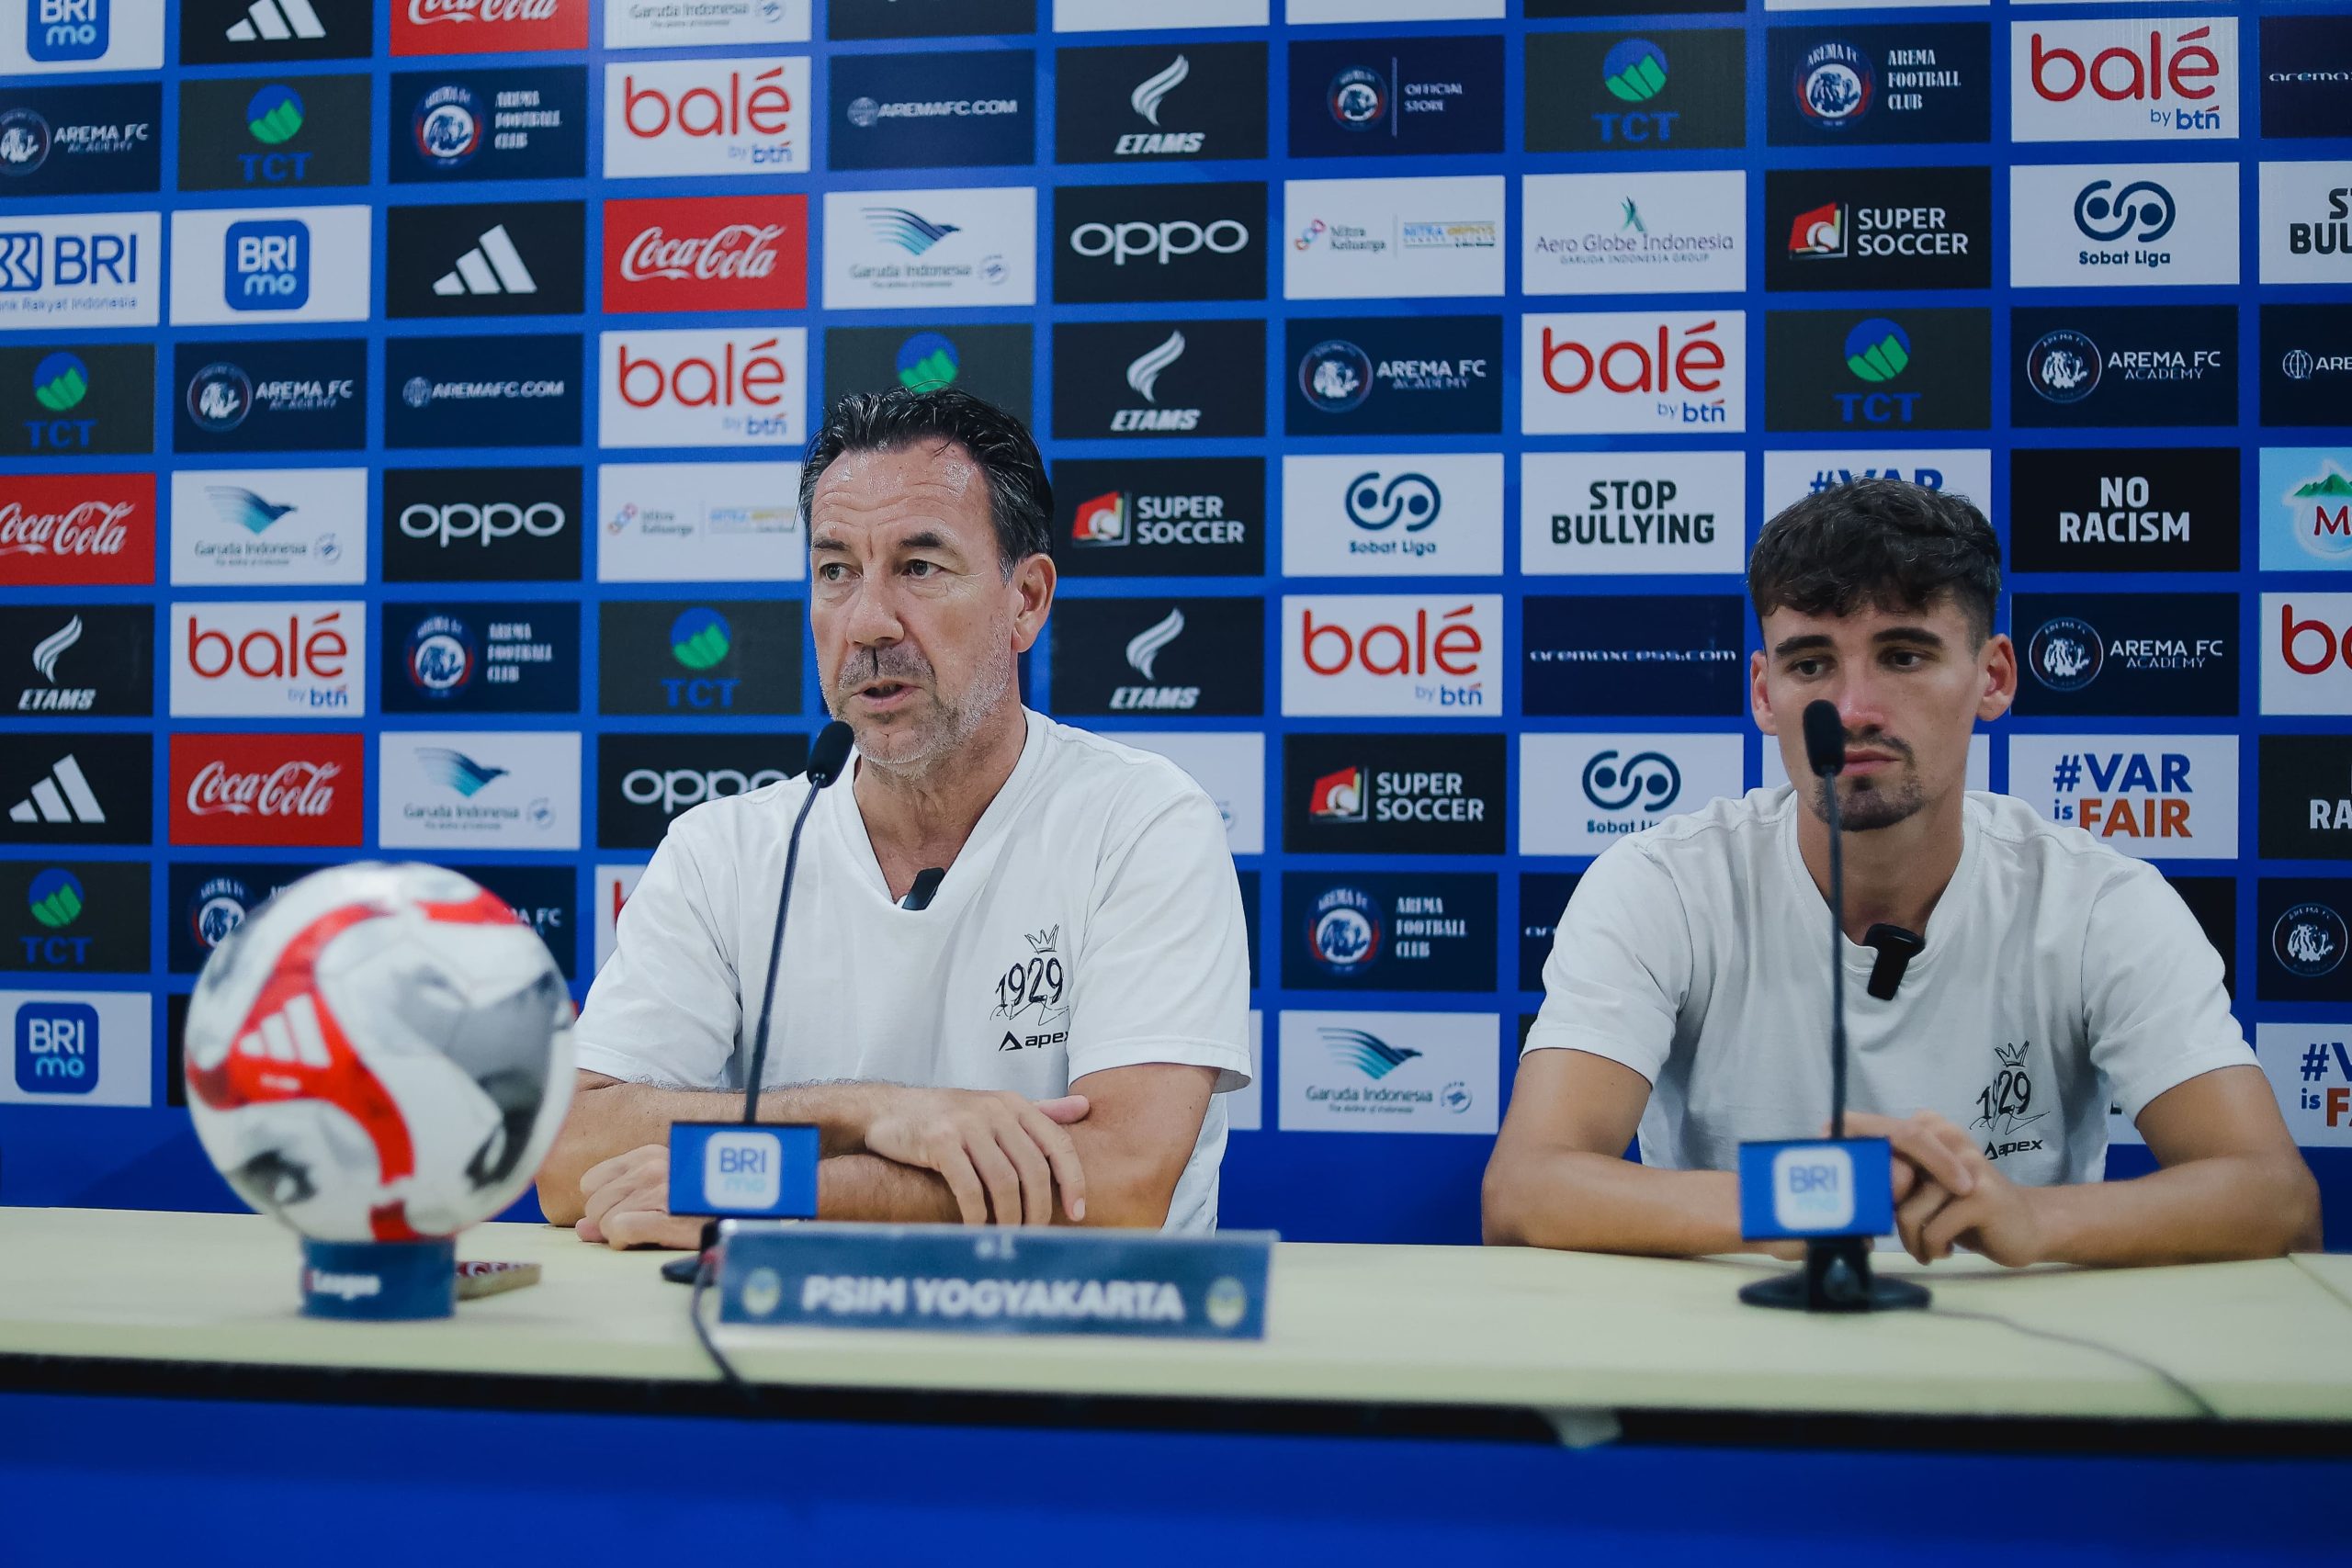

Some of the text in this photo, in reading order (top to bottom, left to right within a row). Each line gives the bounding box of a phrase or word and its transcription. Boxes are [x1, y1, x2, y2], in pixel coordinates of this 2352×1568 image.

[40, 0, 96, 23] BRI
[46, 25, 96, 47] mo
[1888, 49, 1936, 66] AREMA
[2031, 25, 2220, 102] balé
[1888, 71, 1962, 88] FOOTBALL
[2268, 72, 2352, 82] arema
[625, 66, 791, 139] balé
[877, 100, 1017, 118] AREMAFC.COM
[1888, 94, 1923, 110] CLUB
[1593, 111, 1679, 142] TCT
[2150, 109, 2171, 128] by
[53, 123, 150, 142] AREMA FC
[1114, 132, 1204, 155] ETAMS
[237, 152, 314, 182] TCT
[2329, 187, 2352, 220] S
[1858, 208, 1946, 231] SUPER
[238, 236, 297, 272] BRI
[621, 223, 786, 281] Coca-Cola
[1070, 220, 1250, 265] oppo
[1534, 233, 1734, 254] Aero Globe Indonesia
[1858, 233, 1968, 257] SOCCER
[54, 233, 138, 286] BRI
[2079, 251, 2171, 267] Sobat Liga
[243, 273, 297, 297] mo
[1376, 359, 1487, 378] AREMA FC
[1543, 321, 1725, 394] balé
[2108, 351, 2222, 368] AREMA FC
[619, 338, 785, 409] balé
[2125, 368, 2204, 381] ACADEMY
[255, 380, 353, 400] AREMA FC
[1833, 392, 1921, 423] TCT
[1110, 410, 1200, 432] ETAMS
[24, 420, 97, 448] TCT
[1589, 480, 1676, 511] STOP
[2100, 476, 2149, 508] NO
[1137, 496, 1223, 520] SUPER
[400, 502, 565, 547] oppo
[1137, 521, 1245, 545] SOCCER
[1552, 514, 1715, 546] BULLYING
[2060, 511, 2189, 543] RACISM
[1350, 540, 1436, 557] Sobat Liga
[188, 612, 348, 679] balé
[1301, 605, 1482, 676] balé
[2110, 639, 2223, 657] AREMA FC
[2126, 657, 2206, 670] ACADEMY
[17, 688, 96, 710] ETAMS
[661, 679, 741, 707] TCT
[1109, 686, 1199, 709] ETAMS
[1376, 772, 1463, 795] SUPER
[2053, 753, 2193, 793] #VAR
[187, 761, 342, 818] Coca-Cola
[1376, 798, 1485, 822] SOCCER
[2054, 798, 2193, 838] is FAIR
[1588, 820, 1634, 834] Sobat
[1396, 897, 1443, 915] AREMA
[1396, 919, 1467, 937] FOOTBALL
[19, 937, 91, 964] TCT
[1396, 941, 1430, 958] CLUB
[995, 957, 1064, 1009] 1929
[28, 1018, 85, 1055] BRI
[36, 1056, 85, 1079] mo
[1306, 1086, 1433, 1103] Garuda Indonesia
[2301, 1088, 2321, 1110] is
[720, 1147, 766, 1173] BRI
[1789, 1165, 1838, 1193] BRI
[803, 1276, 1186, 1322] PSIM YOGYAKARTA
